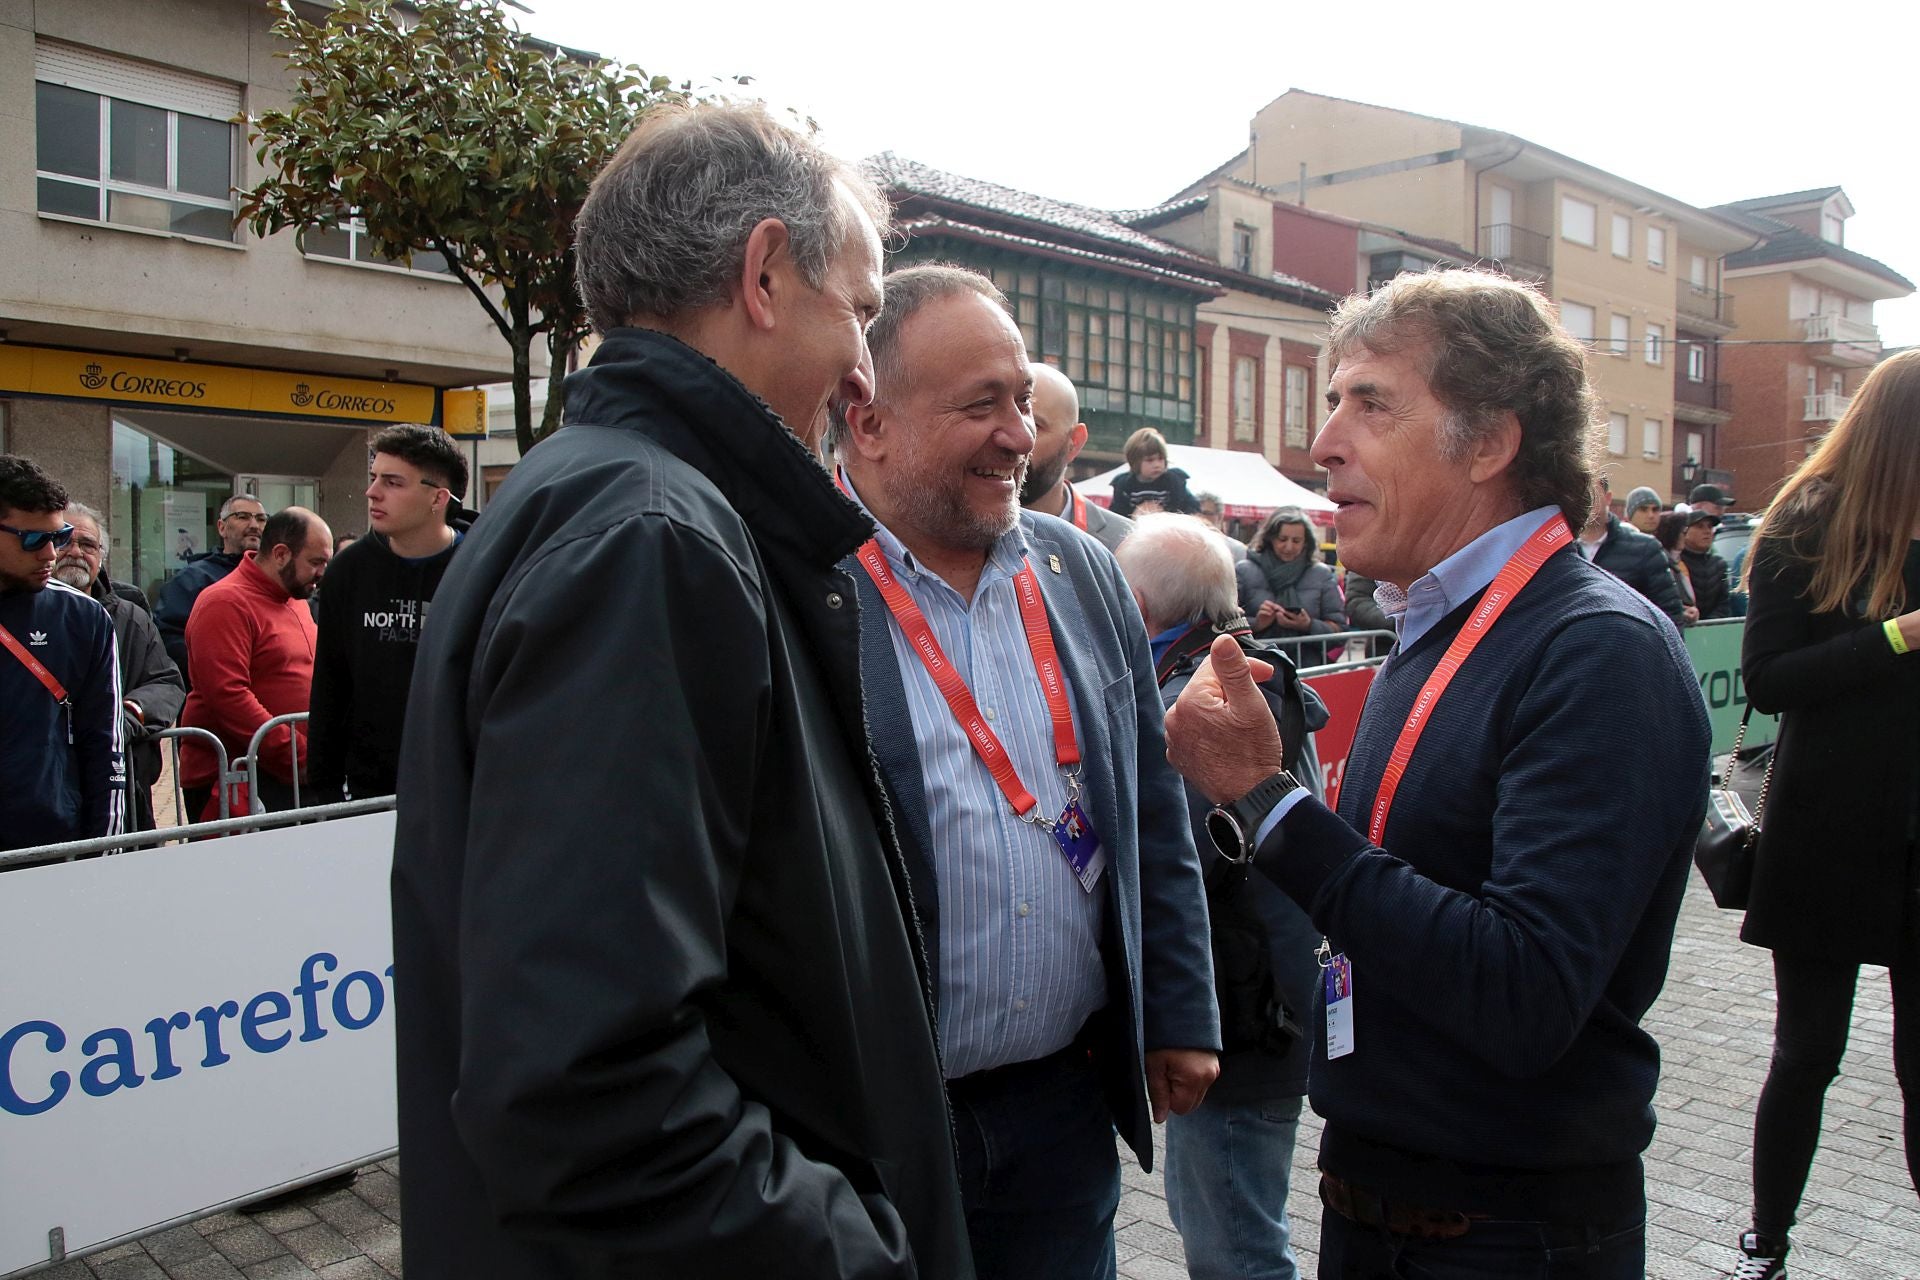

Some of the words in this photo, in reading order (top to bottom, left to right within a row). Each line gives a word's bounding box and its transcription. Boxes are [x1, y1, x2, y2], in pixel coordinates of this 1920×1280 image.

[110, 371, 206, 399] CORREOS
[315, 390, 396, 414] CORREOS
[867, 554, 885, 578] VUELTA
[1020, 574, 1033, 597] VUELTA
[1479, 593, 1502, 618] VUELTA
[918, 635, 936, 660] VUELTA
[1042, 662, 1056, 686] VUELTA
[1413, 691, 1433, 718] VUELTA
[970, 720, 989, 746] VUELTA
[0, 952, 394, 1116] Carrefo
